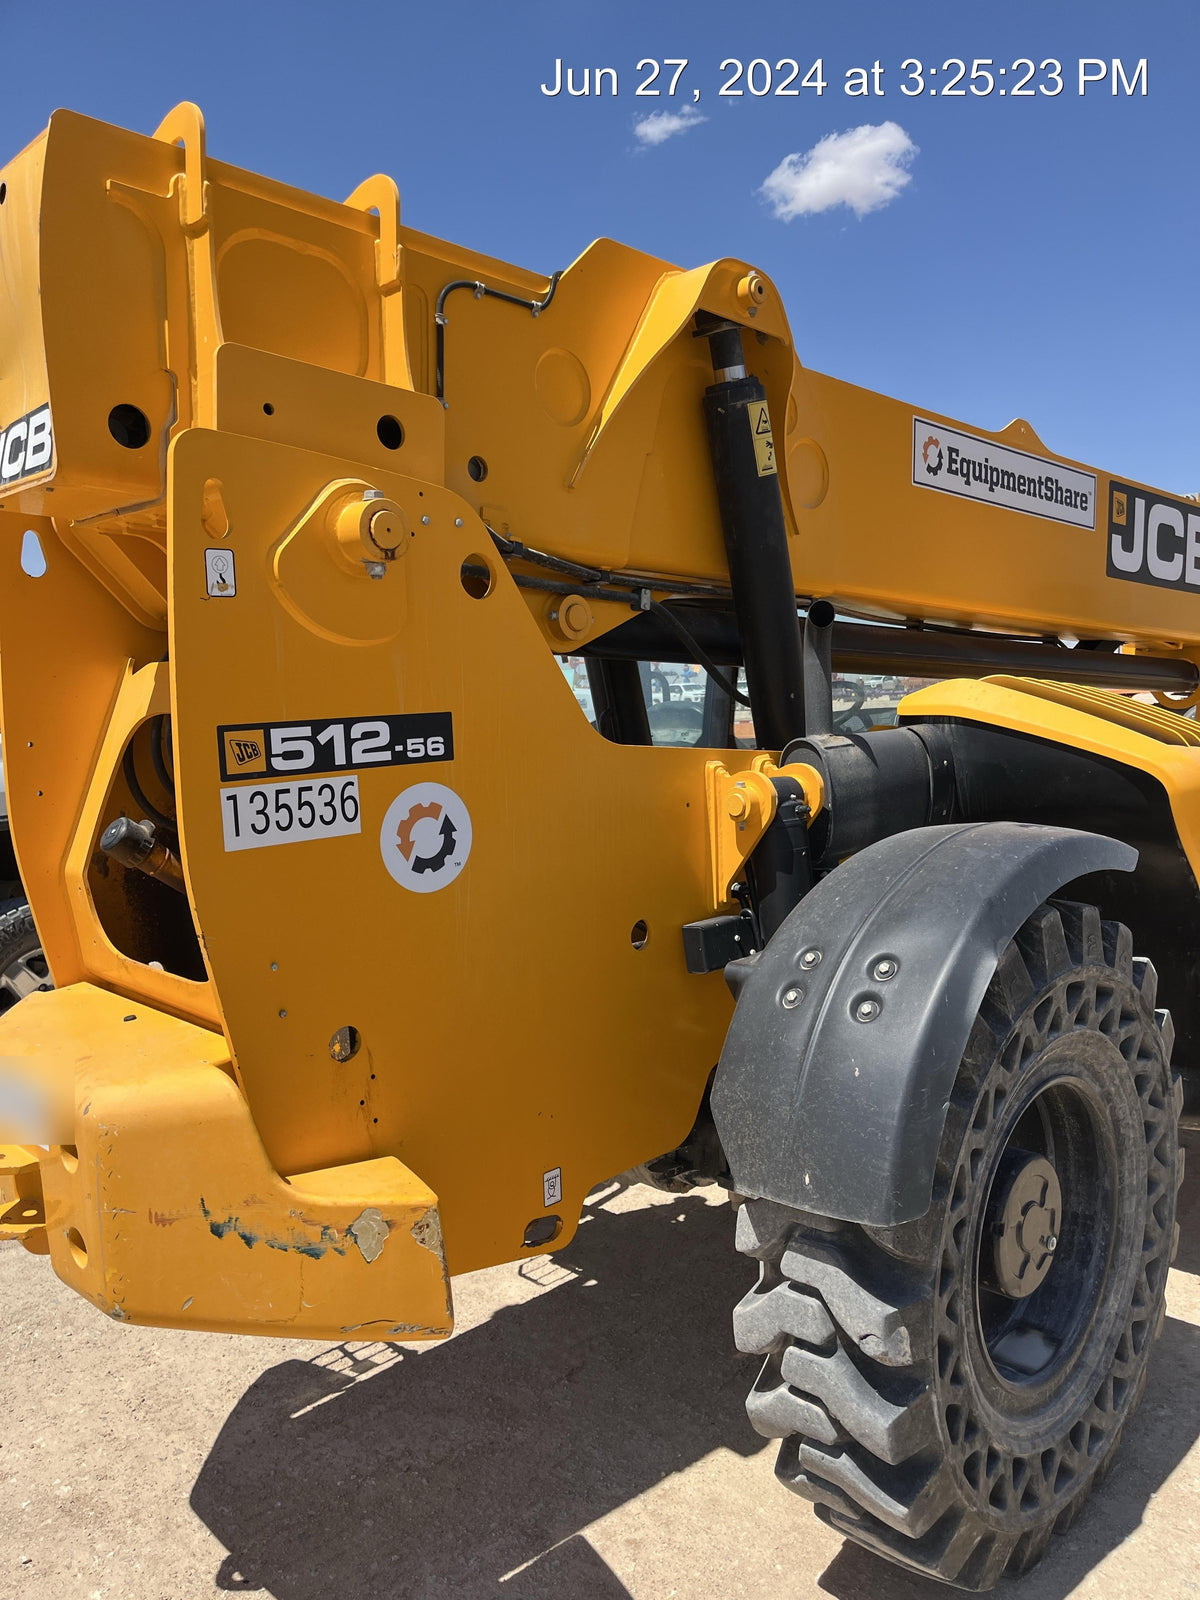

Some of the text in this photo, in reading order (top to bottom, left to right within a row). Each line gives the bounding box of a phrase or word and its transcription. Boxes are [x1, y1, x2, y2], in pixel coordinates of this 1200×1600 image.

[946, 446, 1089, 512] EquipmentShare
[235, 741, 260, 764] JCB
[226, 780, 359, 838] 135536
